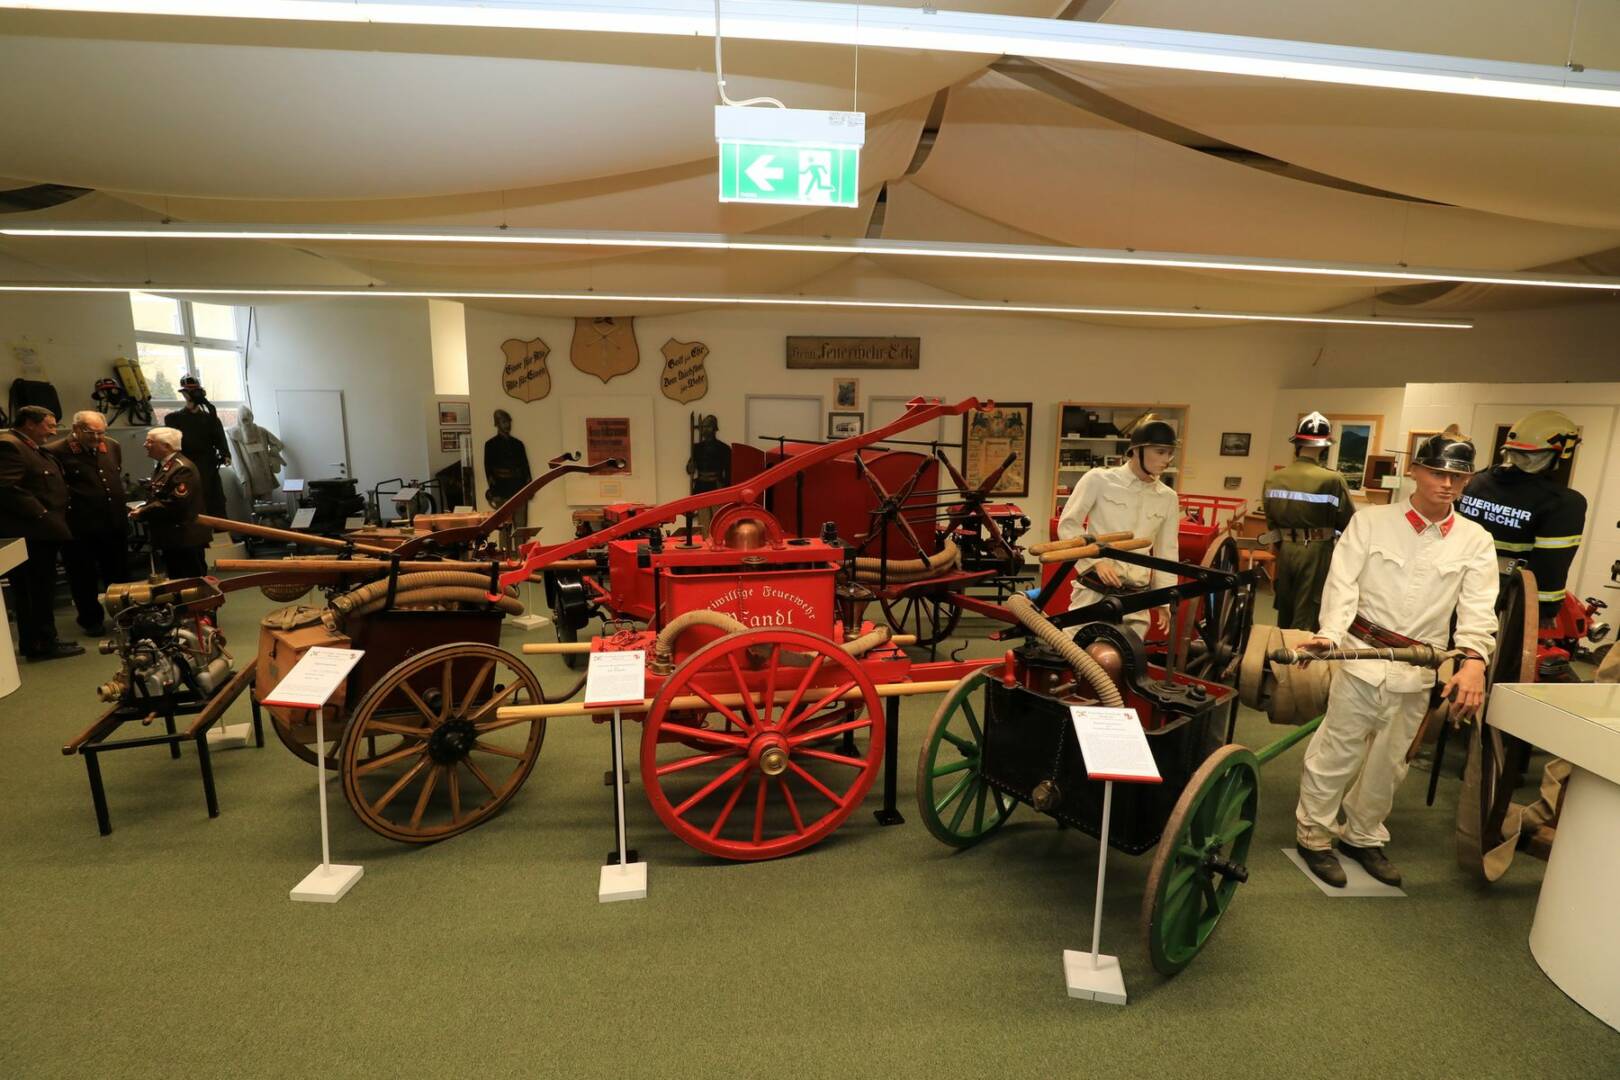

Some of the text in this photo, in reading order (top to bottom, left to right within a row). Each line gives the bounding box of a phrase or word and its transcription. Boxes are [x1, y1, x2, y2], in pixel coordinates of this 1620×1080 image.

[1459, 503, 1521, 529] BAD ISCHL
[707, 585, 816, 620] iwillige Feuerwehr
